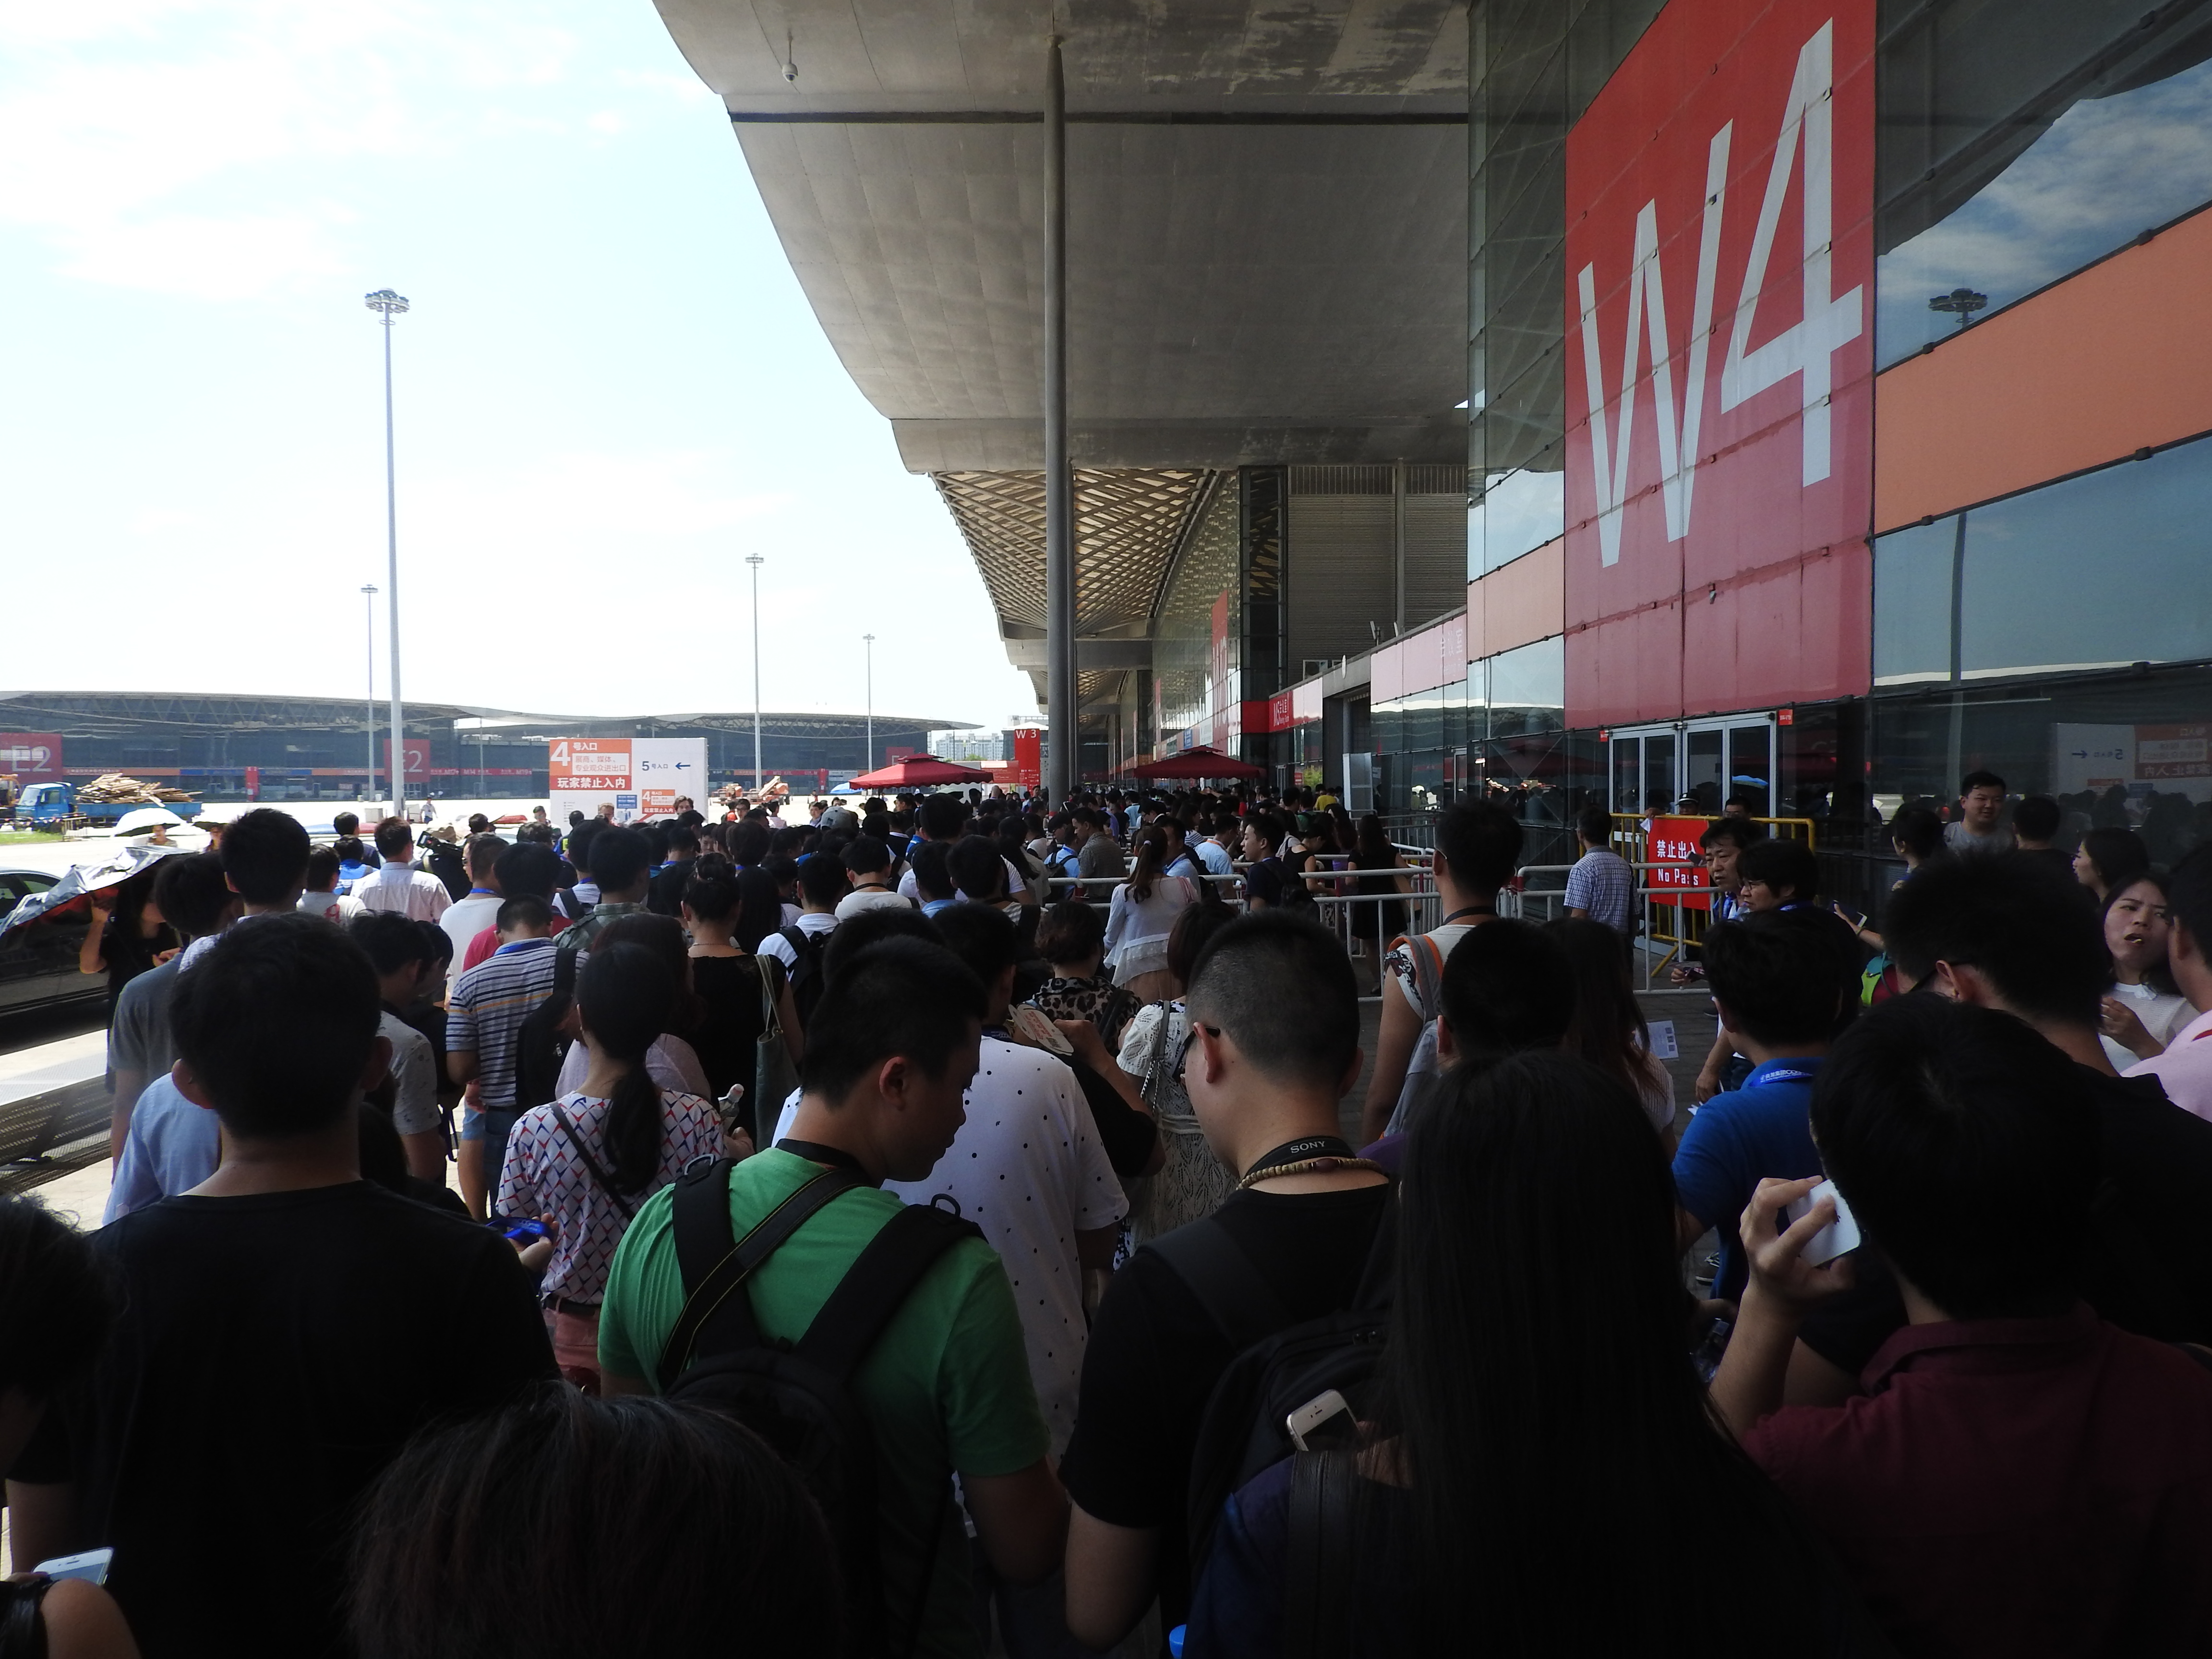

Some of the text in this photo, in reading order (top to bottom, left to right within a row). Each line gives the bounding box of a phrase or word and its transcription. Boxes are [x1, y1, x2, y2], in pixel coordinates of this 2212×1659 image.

[1578, 17, 1863, 568] W4
[1016, 729, 1036, 739] W 3
[12, 745, 51, 772] E2
[403, 750, 422, 772] 2
[551, 742, 597, 767] 4 号入口
[642, 761, 649, 771] 5
[557, 777, 625, 788] 玩家禁止入内
[642, 791, 651, 802] 4
[1658, 868, 1670, 882] No
[1290, 1141, 1325, 1154] SONY
